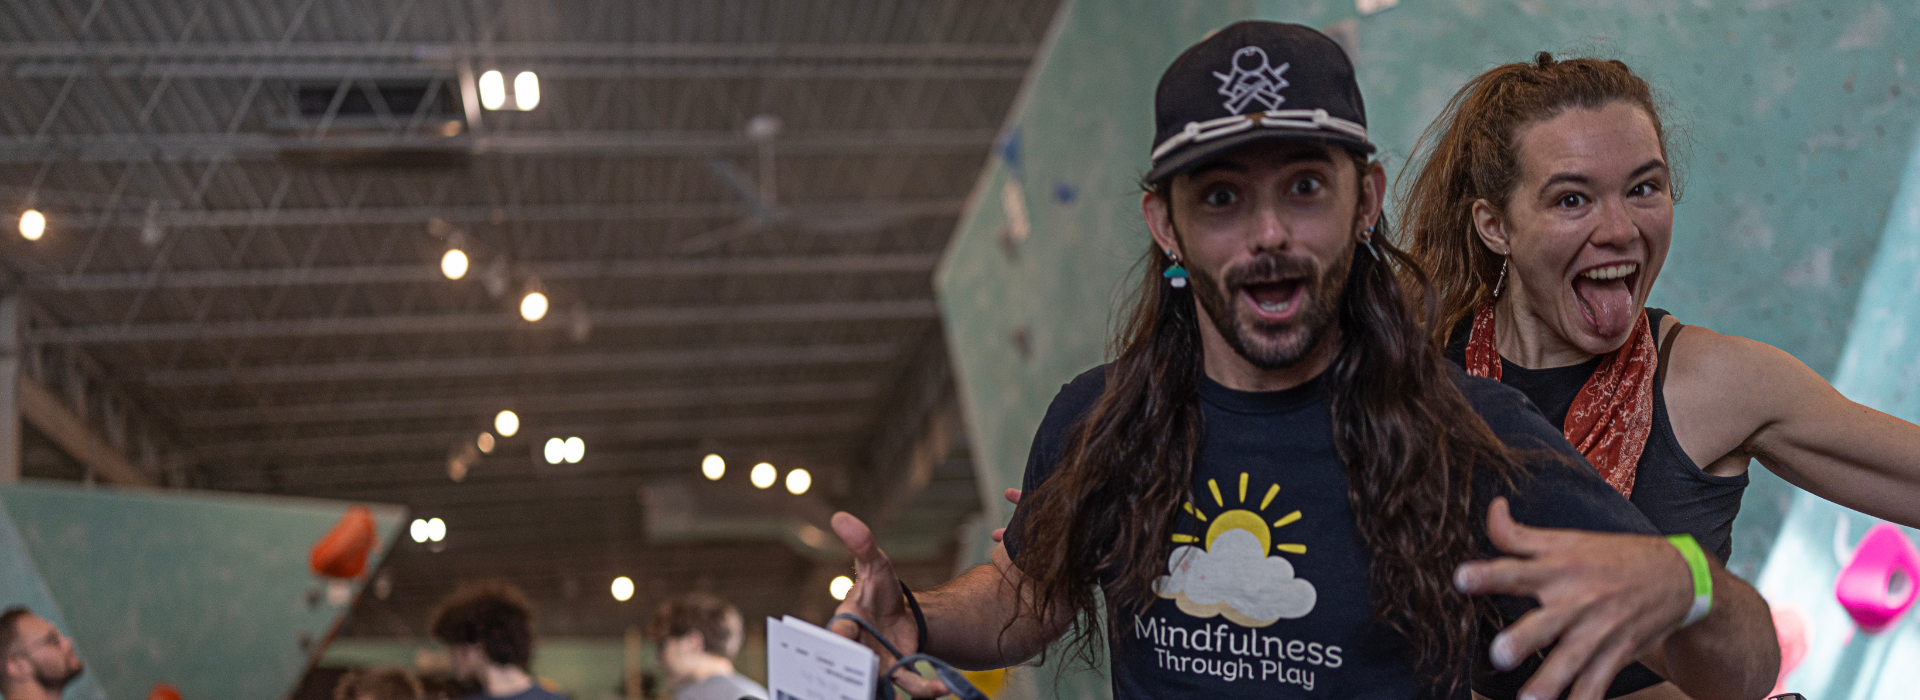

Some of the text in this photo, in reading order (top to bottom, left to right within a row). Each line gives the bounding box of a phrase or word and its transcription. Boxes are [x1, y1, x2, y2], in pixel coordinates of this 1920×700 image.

[1134, 614, 1343, 669] Mindfulness
[1154, 647, 1314, 691] Through Play
